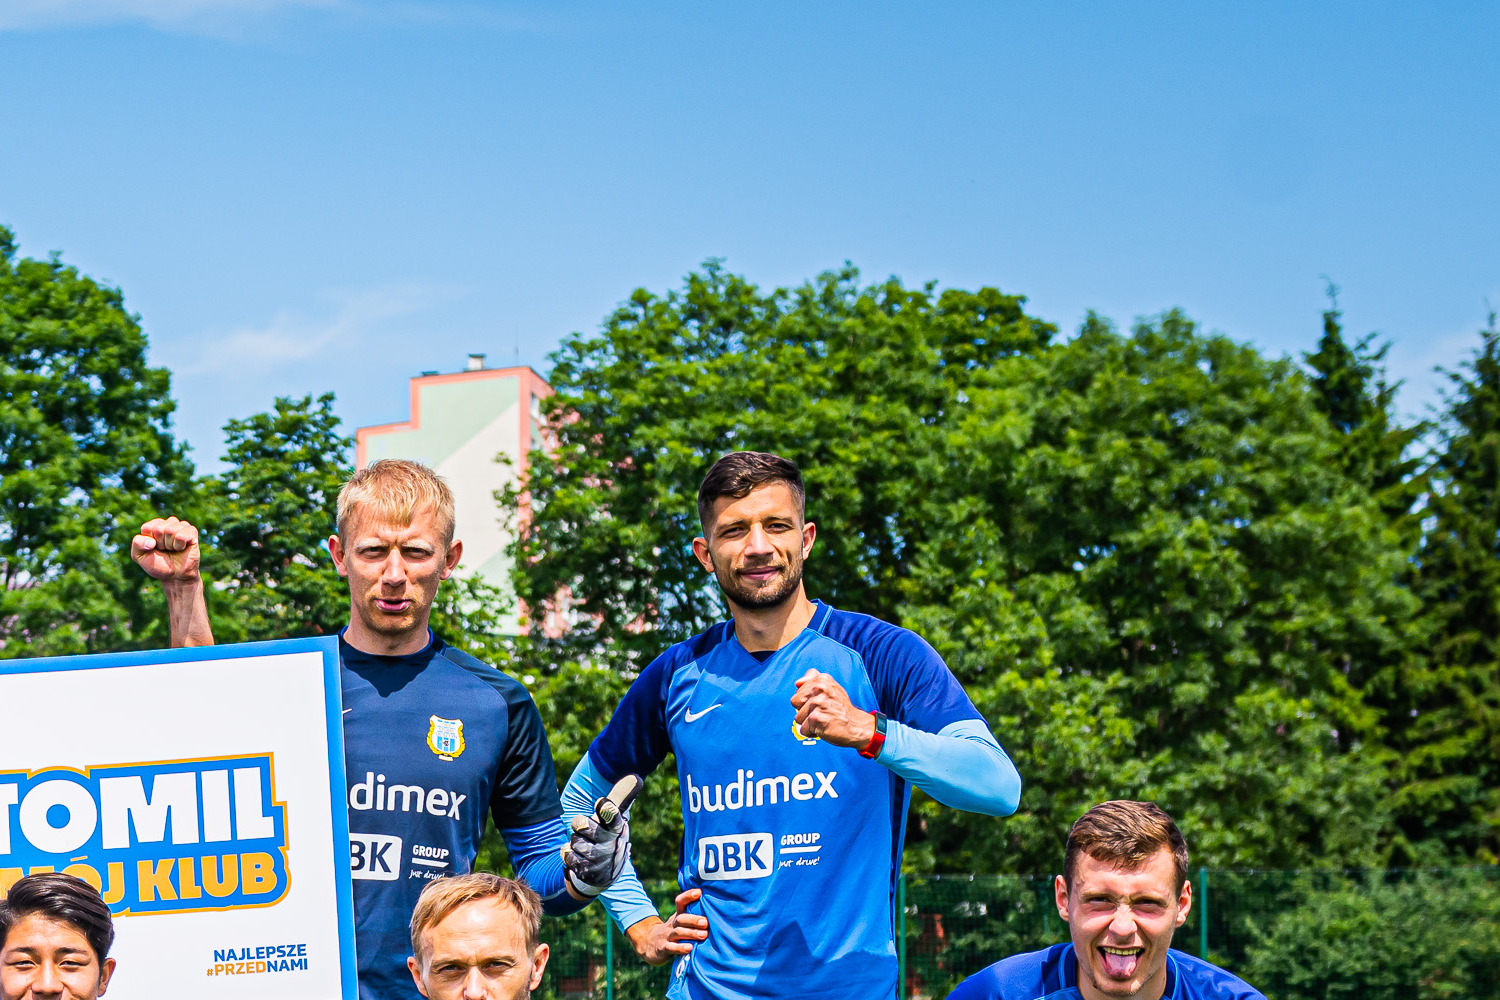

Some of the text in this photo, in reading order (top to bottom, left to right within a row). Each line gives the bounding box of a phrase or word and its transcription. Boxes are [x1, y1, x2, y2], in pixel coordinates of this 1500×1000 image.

[347, 771, 467, 820] dimex
[687, 769, 839, 813] budimex
[349, 841, 450, 874] BK GROUP
[704, 833, 821, 873] DBK GROUP
[137, 852, 278, 902] KLUB
[206, 958, 308, 976] #PRZEDNAMI
[214, 944, 307, 962] NAJLEPSZE
